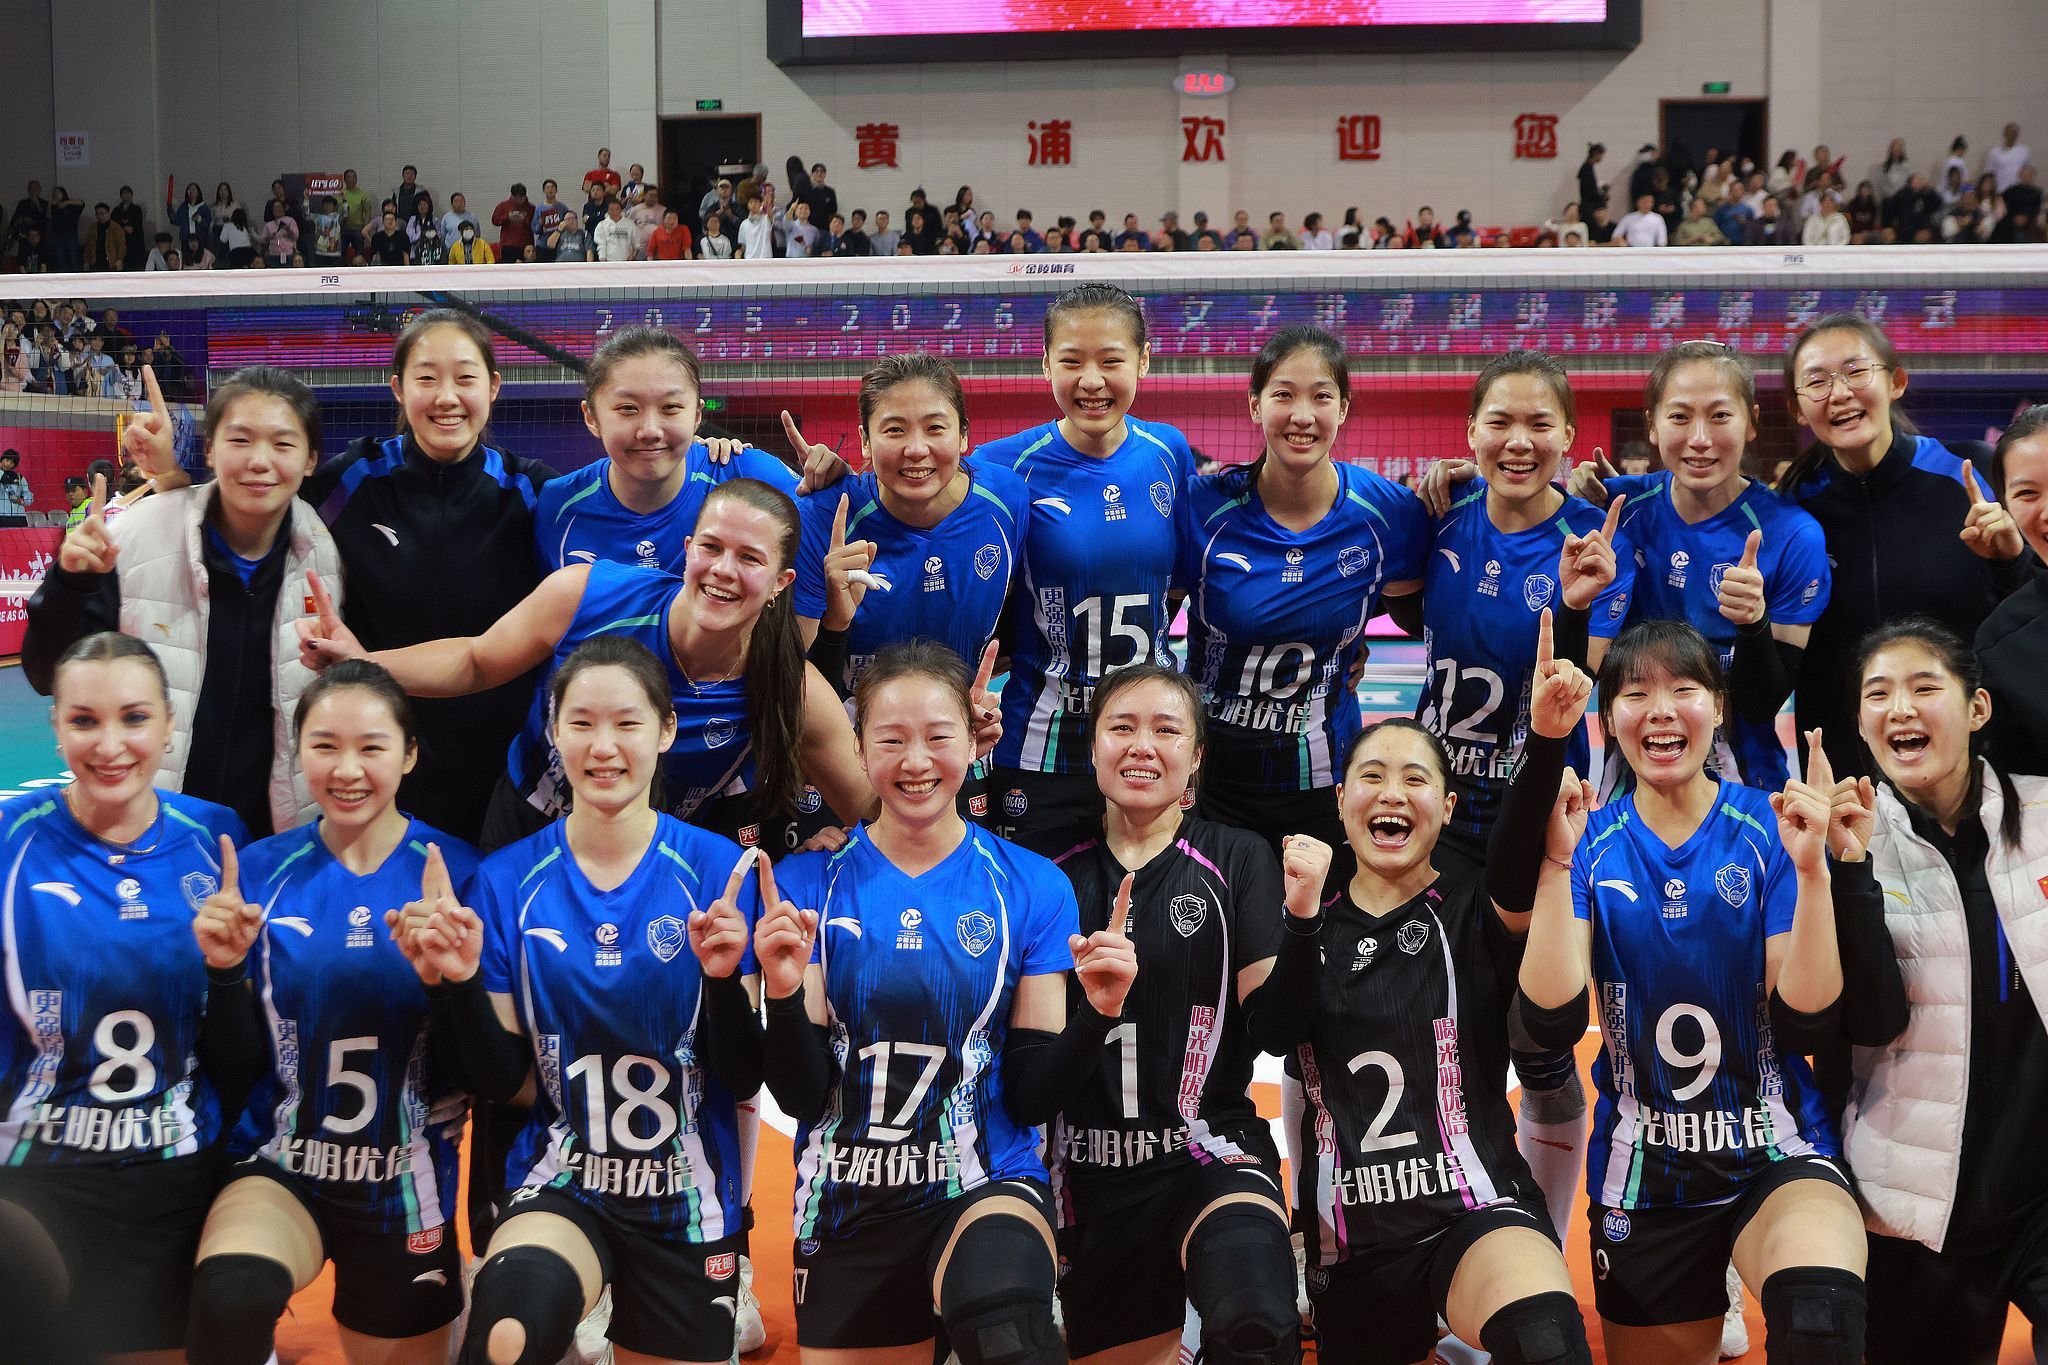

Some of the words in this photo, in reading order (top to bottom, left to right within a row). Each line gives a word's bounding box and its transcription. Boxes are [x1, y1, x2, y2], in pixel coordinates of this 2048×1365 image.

[856, 113, 1559, 168] 黄浦欢迎您
[328, 179, 339, 188] GO
[321, 275, 339, 283] FIVB
[1025, 263, 1075, 274] 金陵体育
[0, 609, 28, 622] EASON
[1073, 594, 1150, 677] 15
[1238, 642, 1315, 699] 10
[1435, 657, 1504, 743] 12
[1005, 796, 1024, 809] 优倍
[784, 822, 798, 848] 6
[88, 1009, 156, 1103] 8
[1179, 1006, 1215, 1119] 喝光明优倍
[1604, 983, 1634, 1097] 更强保护力
[1655, 1002, 1722, 1101] 9
[321, 1036, 379, 1135] 5
[858, 1041, 947, 1126] 17
[1104, 1022, 1139, 1119] 1
[1434, 1018, 1469, 1136] 喝光明优倍
[565, 1054, 677, 1155] 18
[1347, 1050, 1418, 1153] 2
[1633, 1105, 1778, 1154] 光明优倍
[817, 1140, 962, 1187] 光明优倍
[1330, 1152, 1472, 1206] 光明优倍
[411, 1231, 441, 1246] 光明
[1605, 1215, 1629, 1233] 优倍
[709, 1257, 733, 1271] 光明
[1596, 1248, 1611, 1281] 9
